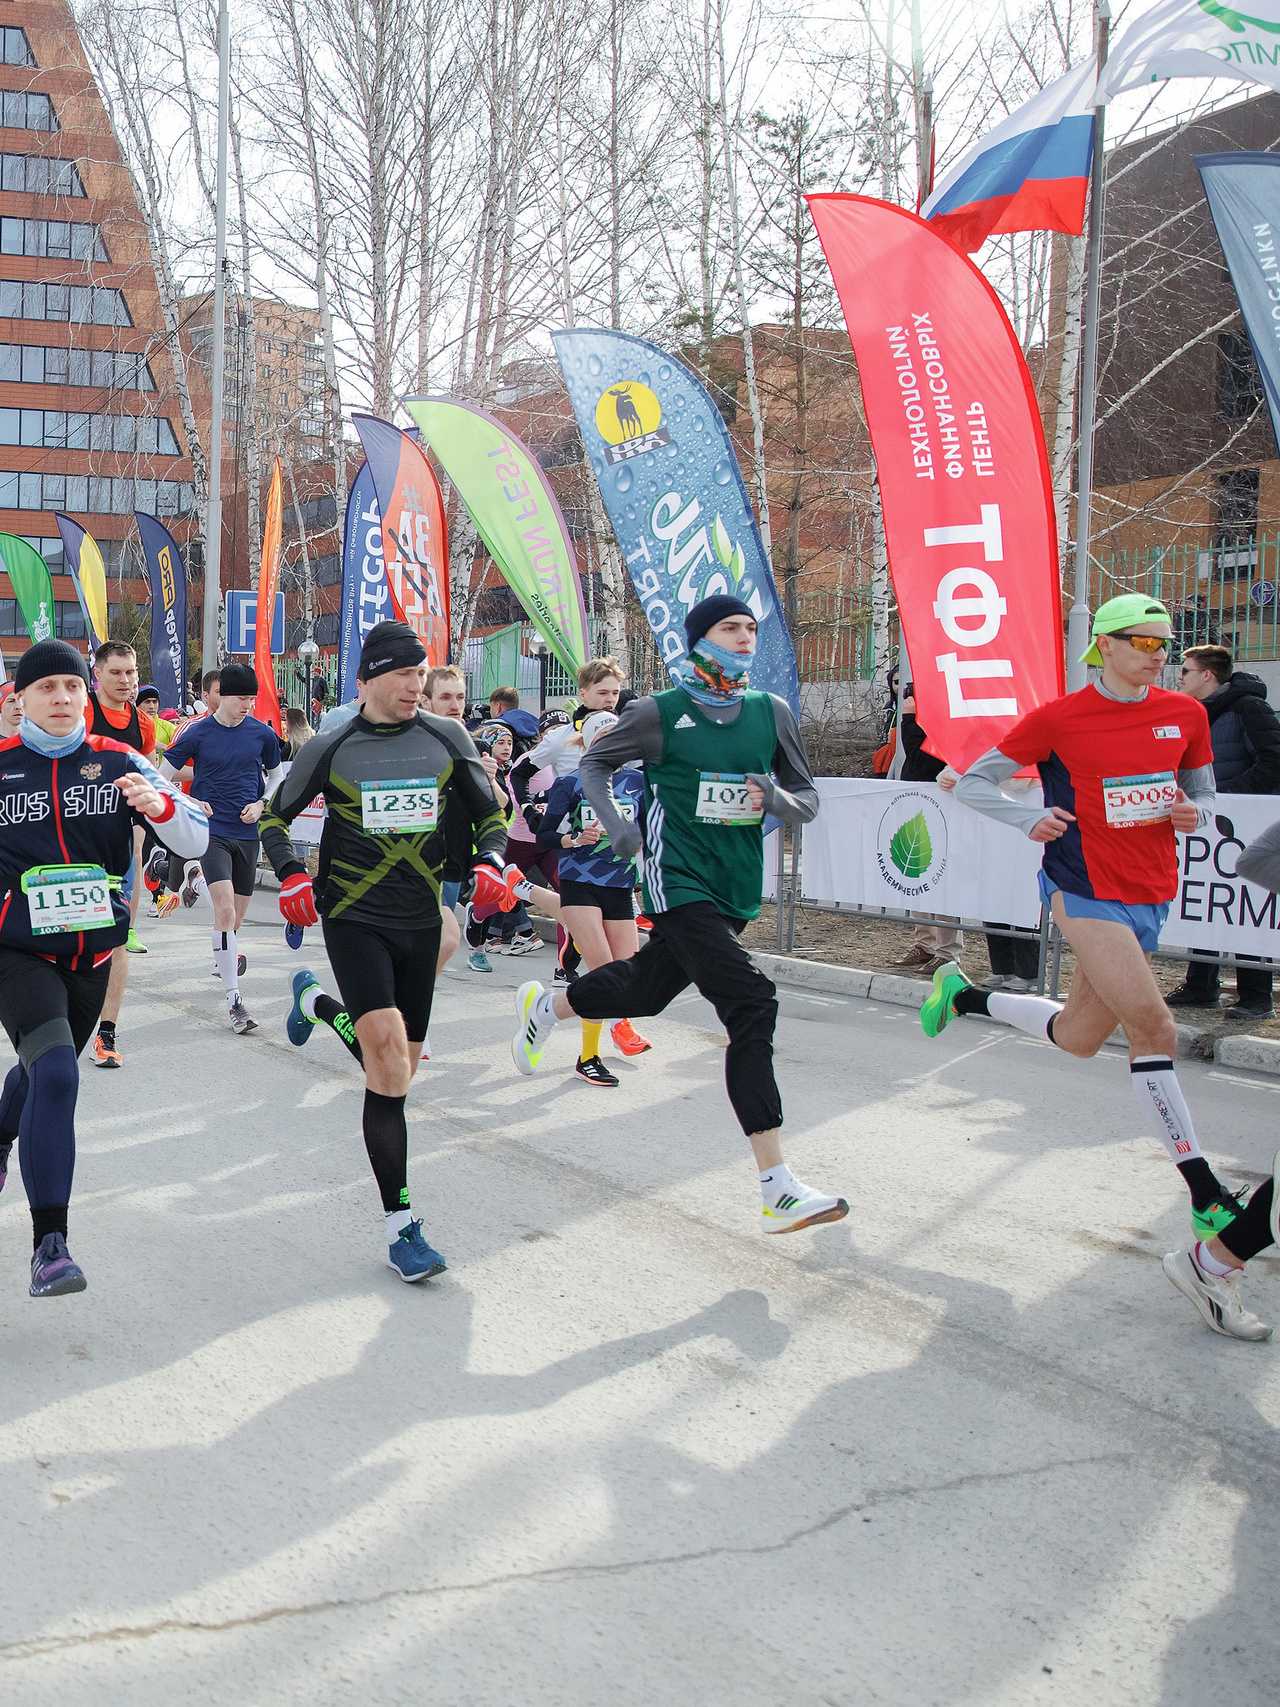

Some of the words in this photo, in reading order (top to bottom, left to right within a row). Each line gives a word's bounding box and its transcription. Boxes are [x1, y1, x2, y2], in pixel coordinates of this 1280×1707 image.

[367, 793, 434, 813] 1238
[703, 786, 749, 805] 107
[890, 791, 919, 806] НАТУРАЛЬНАЯ
[920, 793, 940, 809] ЧИСТОТА
[1107, 785, 1176, 808] 5008
[370, 827, 390, 835] 10.0
[876, 852, 930, 897] АКАДЕМИЧЕСКИЕ
[931, 858, 948, 885] БАНИ
[35, 885, 106, 911] 1150
[1179, 880, 1280, 930] ERM
[39, 926, 61, 935] 10.0
